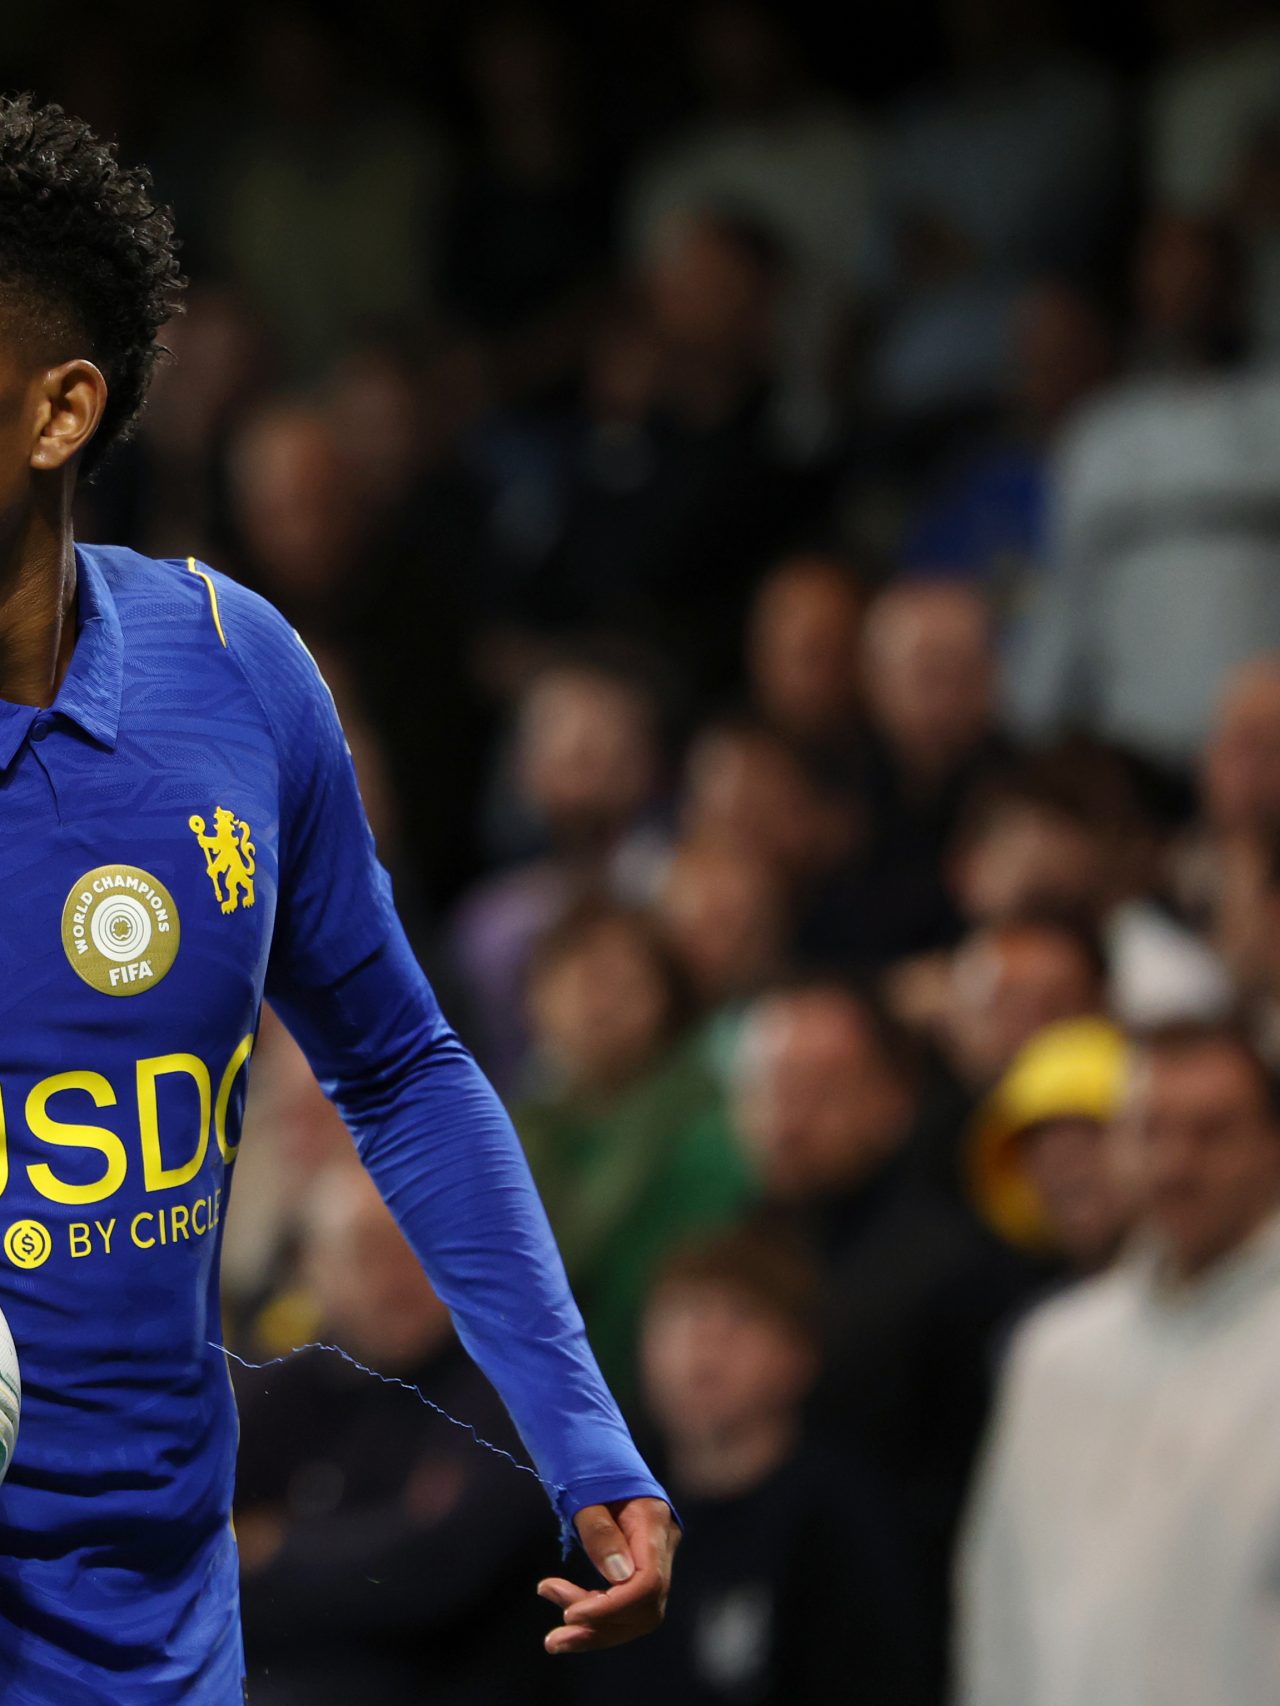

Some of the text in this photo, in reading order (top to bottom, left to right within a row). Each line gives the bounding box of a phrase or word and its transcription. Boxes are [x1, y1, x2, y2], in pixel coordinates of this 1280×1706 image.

[73, 875, 169, 954] WORLD CHAMPIONS
[109, 961, 153, 986] FIFA
[69, 1188, 222, 1258] BY CIRCLE
